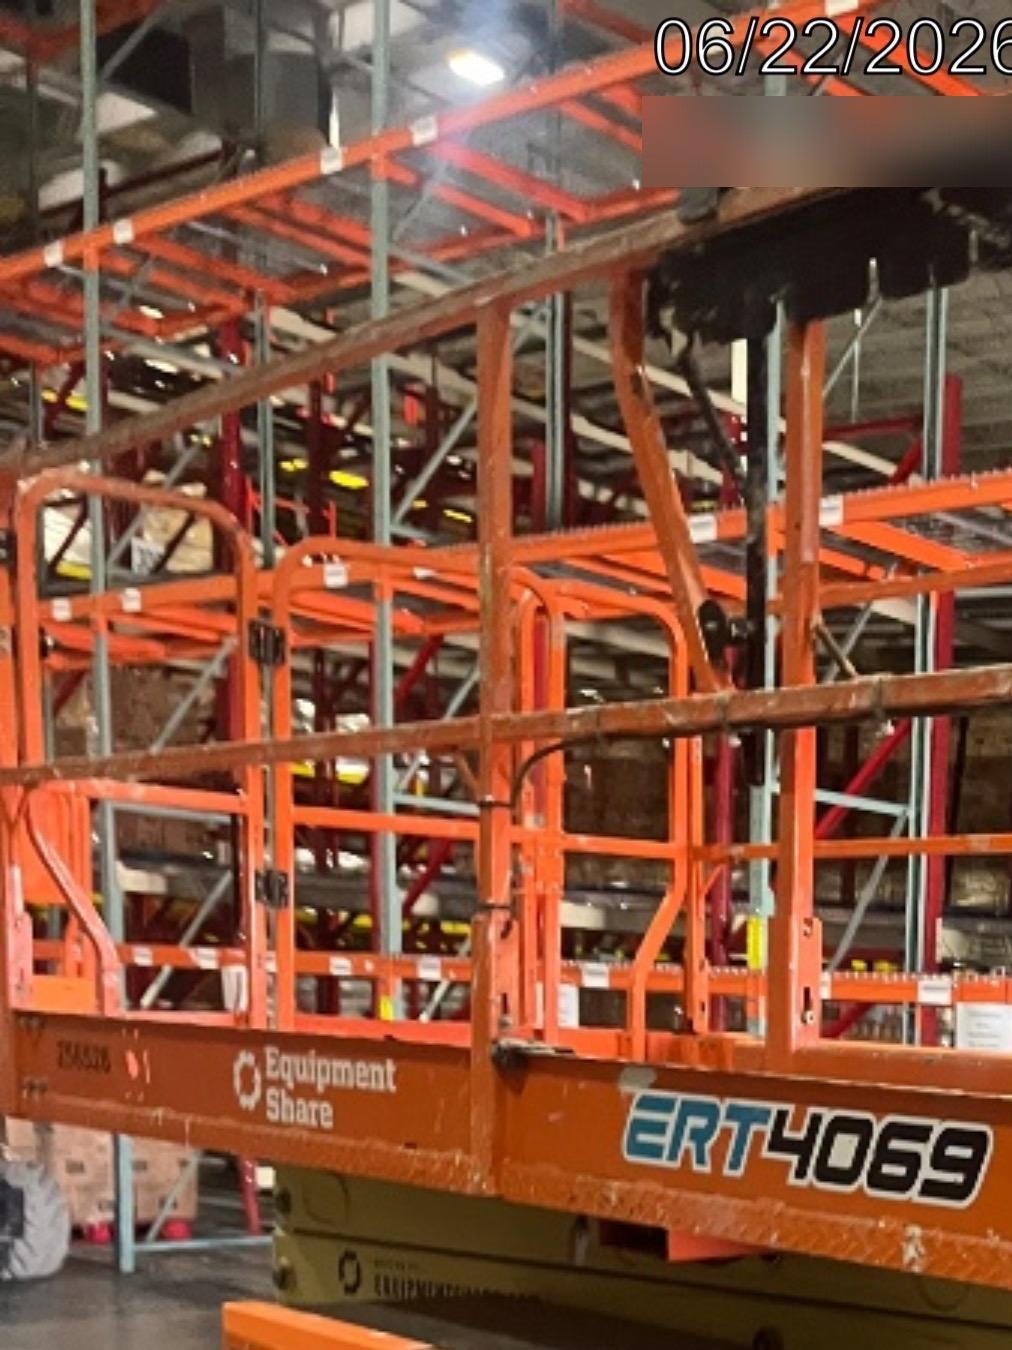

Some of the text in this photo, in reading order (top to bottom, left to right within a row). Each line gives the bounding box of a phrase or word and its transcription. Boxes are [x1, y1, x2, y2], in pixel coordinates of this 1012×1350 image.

[264, 1046, 397, 1094] Equipment
[265, 1086, 334, 1130] Share
[622, 1088, 994, 1209] ERT4069
